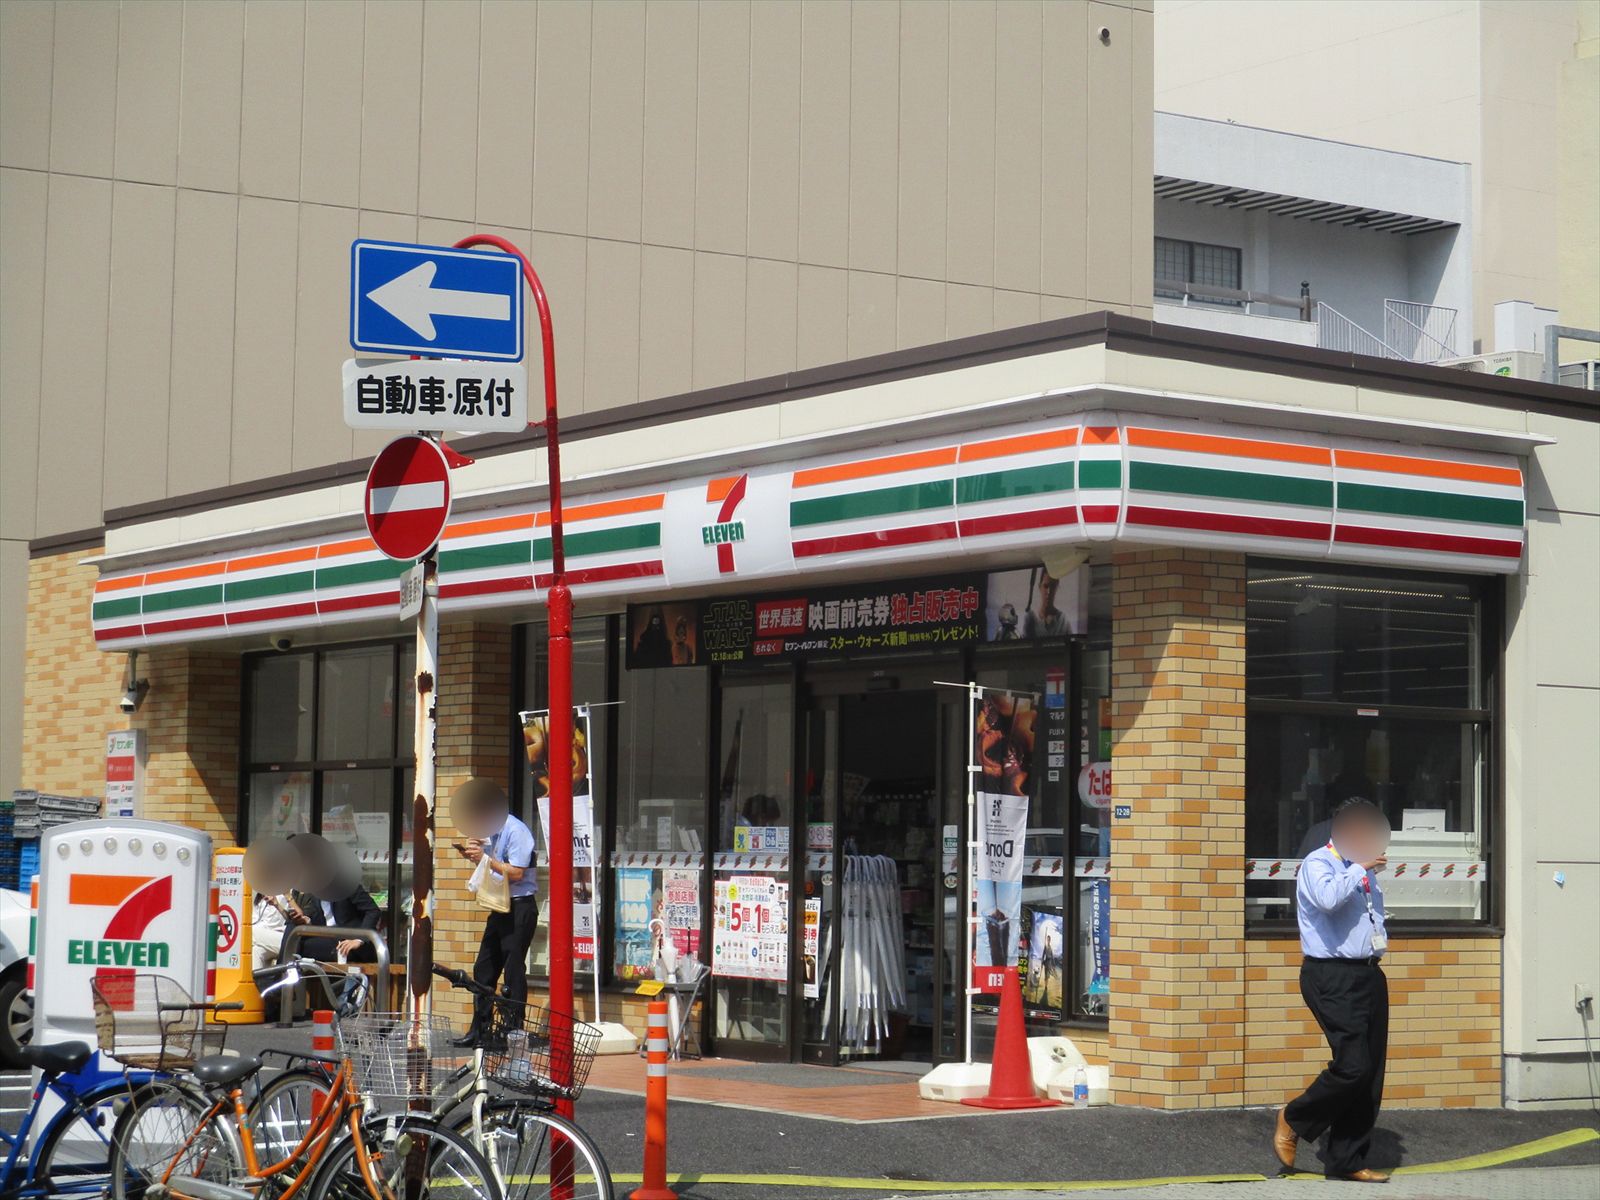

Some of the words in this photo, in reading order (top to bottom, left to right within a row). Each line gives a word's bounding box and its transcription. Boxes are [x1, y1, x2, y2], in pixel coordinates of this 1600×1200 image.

[357, 374, 514, 417] 自動車・原付
[703, 600, 753, 624] STAR
[758, 607, 805, 629] 世界最速
[703, 626, 753, 650] WARS
